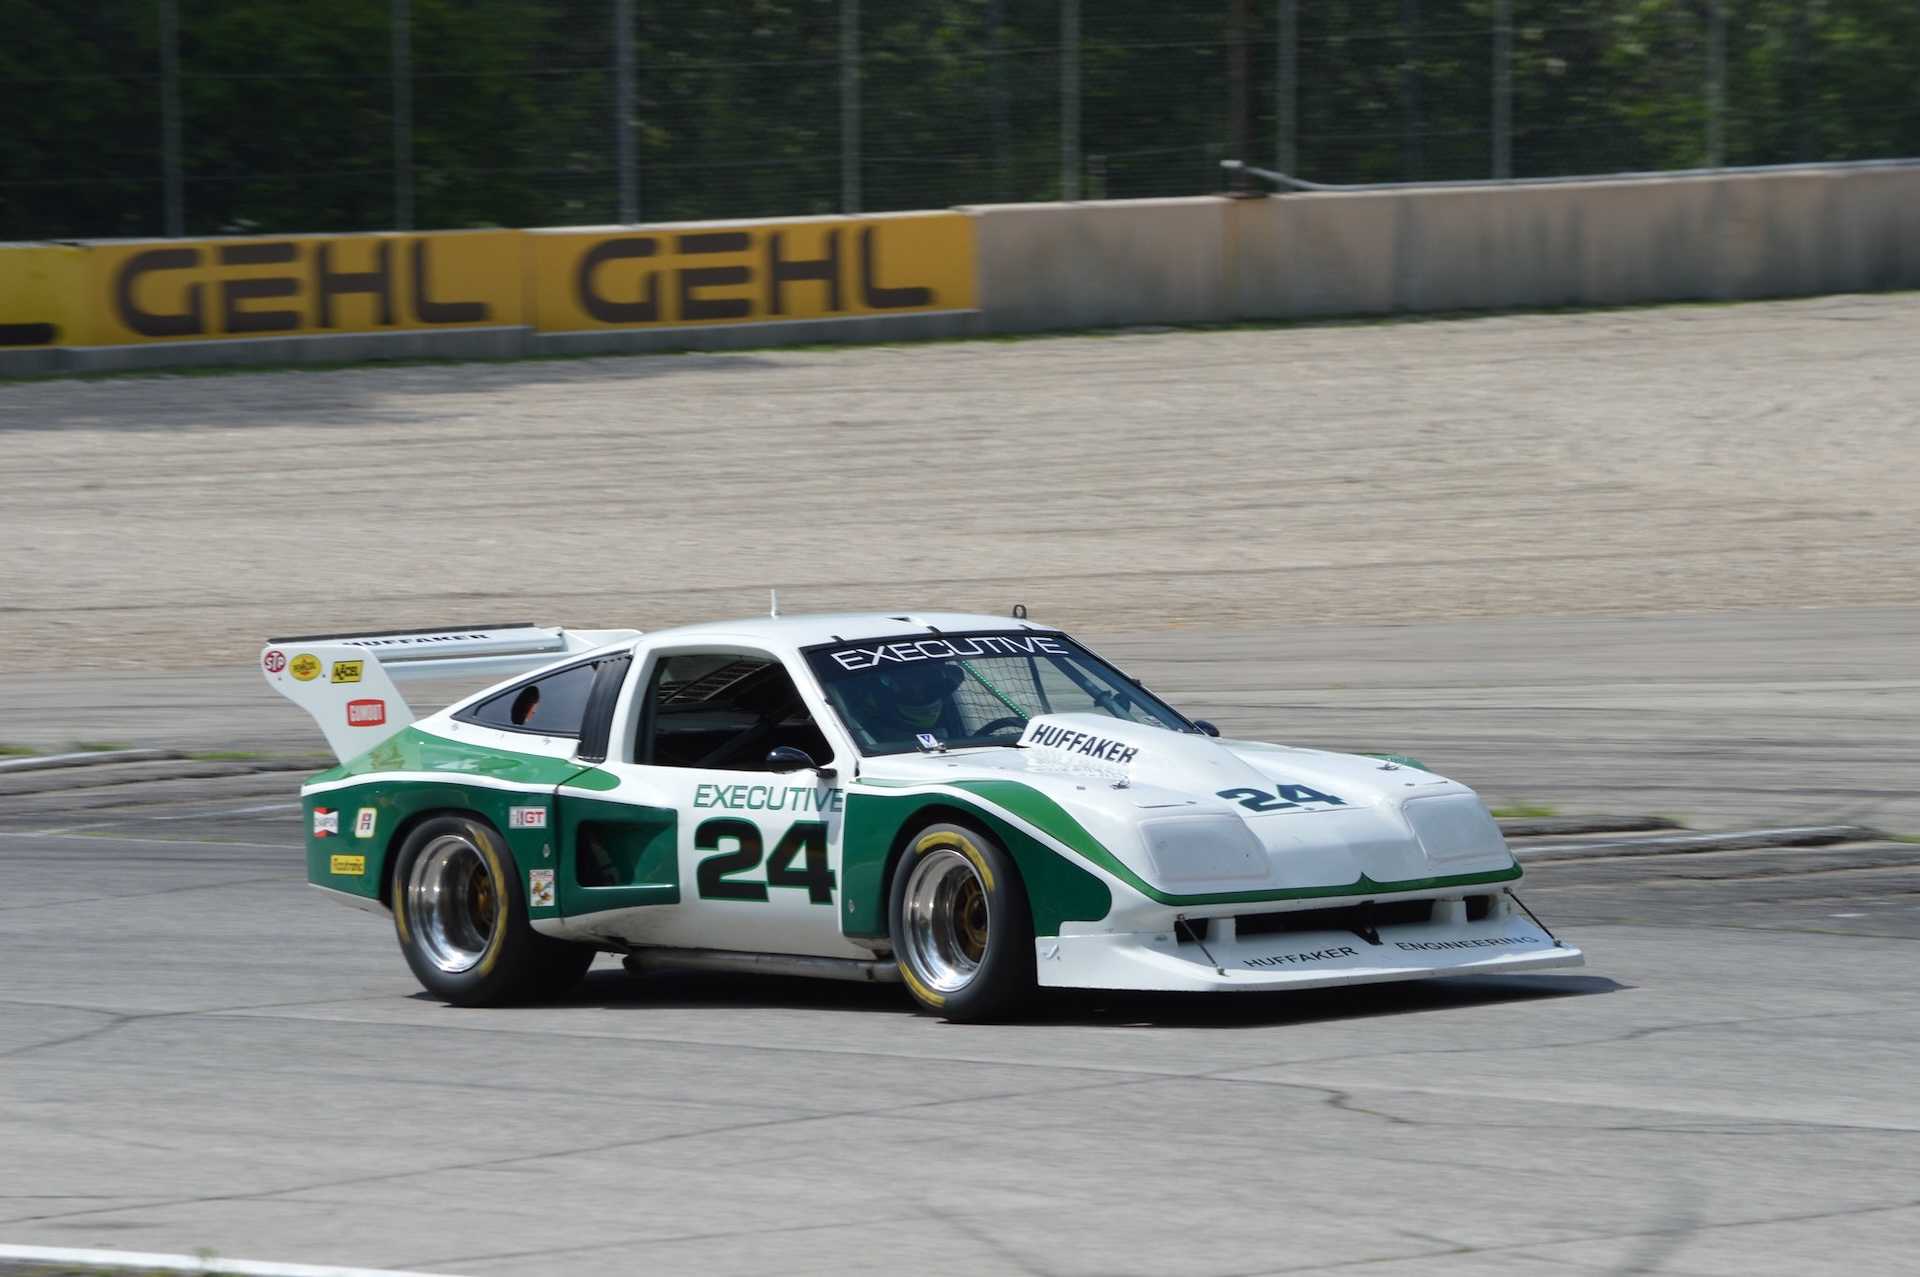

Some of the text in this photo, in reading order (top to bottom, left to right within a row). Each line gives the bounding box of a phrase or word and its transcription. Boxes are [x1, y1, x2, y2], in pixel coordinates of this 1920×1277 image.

[115, 240, 490, 337] GEHL
[577, 226, 938, 323] GEHL
[264, 651, 287, 672] STP
[831, 636, 1069, 671] EXECUTIVE
[1029, 723, 1139, 764] HUFFAKER
[693, 783, 844, 813] EXECUTIVE
[1216, 783, 1347, 812] 24
[525, 810, 545, 825] GT
[694, 815, 838, 906] 24
[1243, 934, 1540, 968] HUFFAKER ENGINEERING
